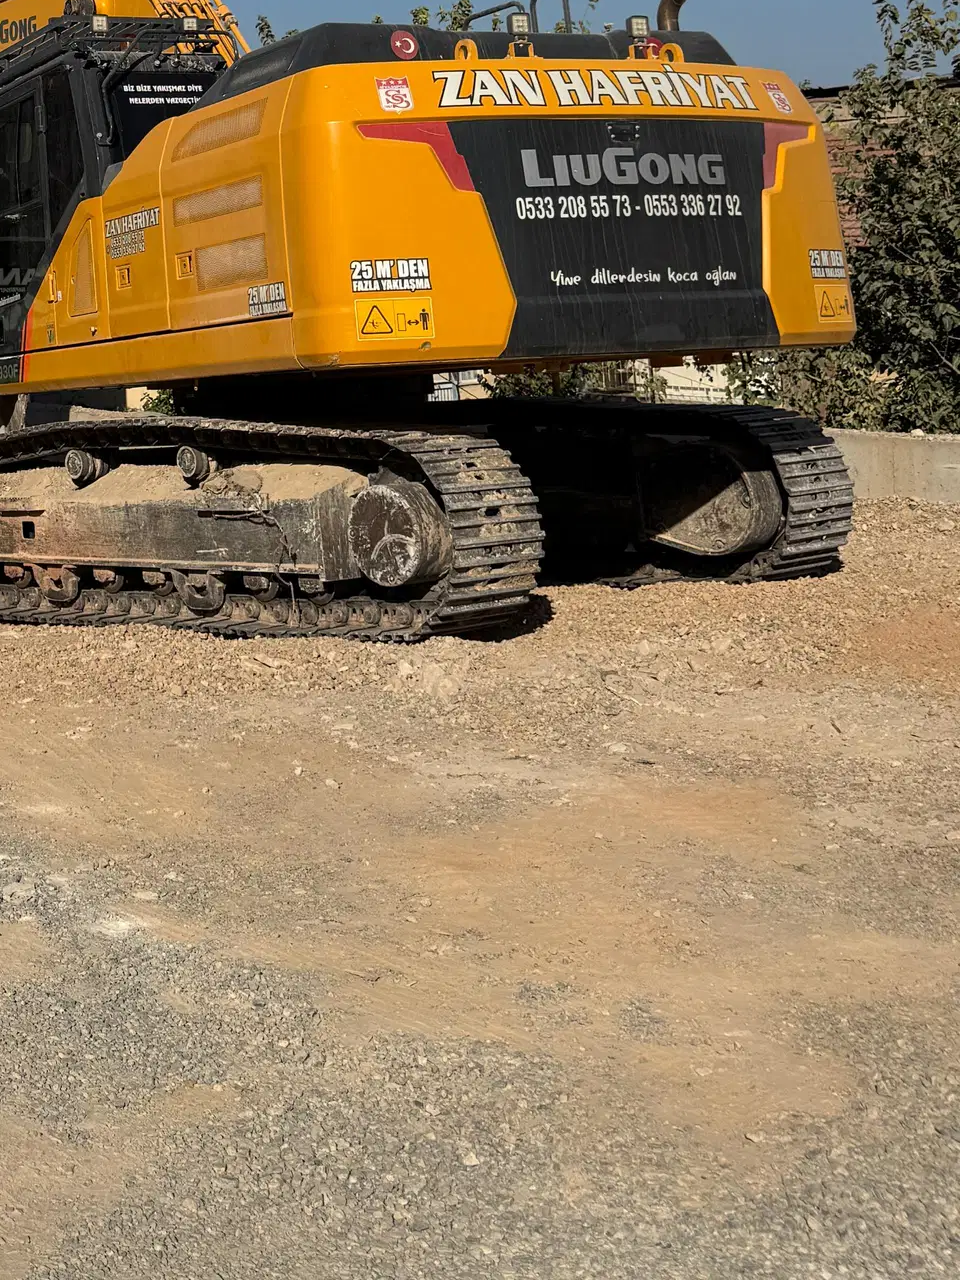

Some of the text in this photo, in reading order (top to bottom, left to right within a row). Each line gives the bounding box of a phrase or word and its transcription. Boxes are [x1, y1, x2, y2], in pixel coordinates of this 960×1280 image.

[432, 63, 760, 111] ZAN HAFRİYAT
[515, 196, 555, 220] 0533
[558, 196, 587, 218] 208
[590, 195, 609, 217] 55
[612, 195, 631, 217] 73
[643, 194, 677, 216] 0553
[680, 195, 705, 216] 336
[708, 195, 722, 216] 27
[725, 194, 742, 216] 92
[105, 219, 121, 238] ZAN
[808, 249, 820, 267] 25
[350, 260, 374, 280] 25
[550, 266, 737, 286] Yine dillerdesin koca oğlan
[352, 278, 431, 292] FAZLA YAKLAŞMA
[248, 287, 259, 305] 25
